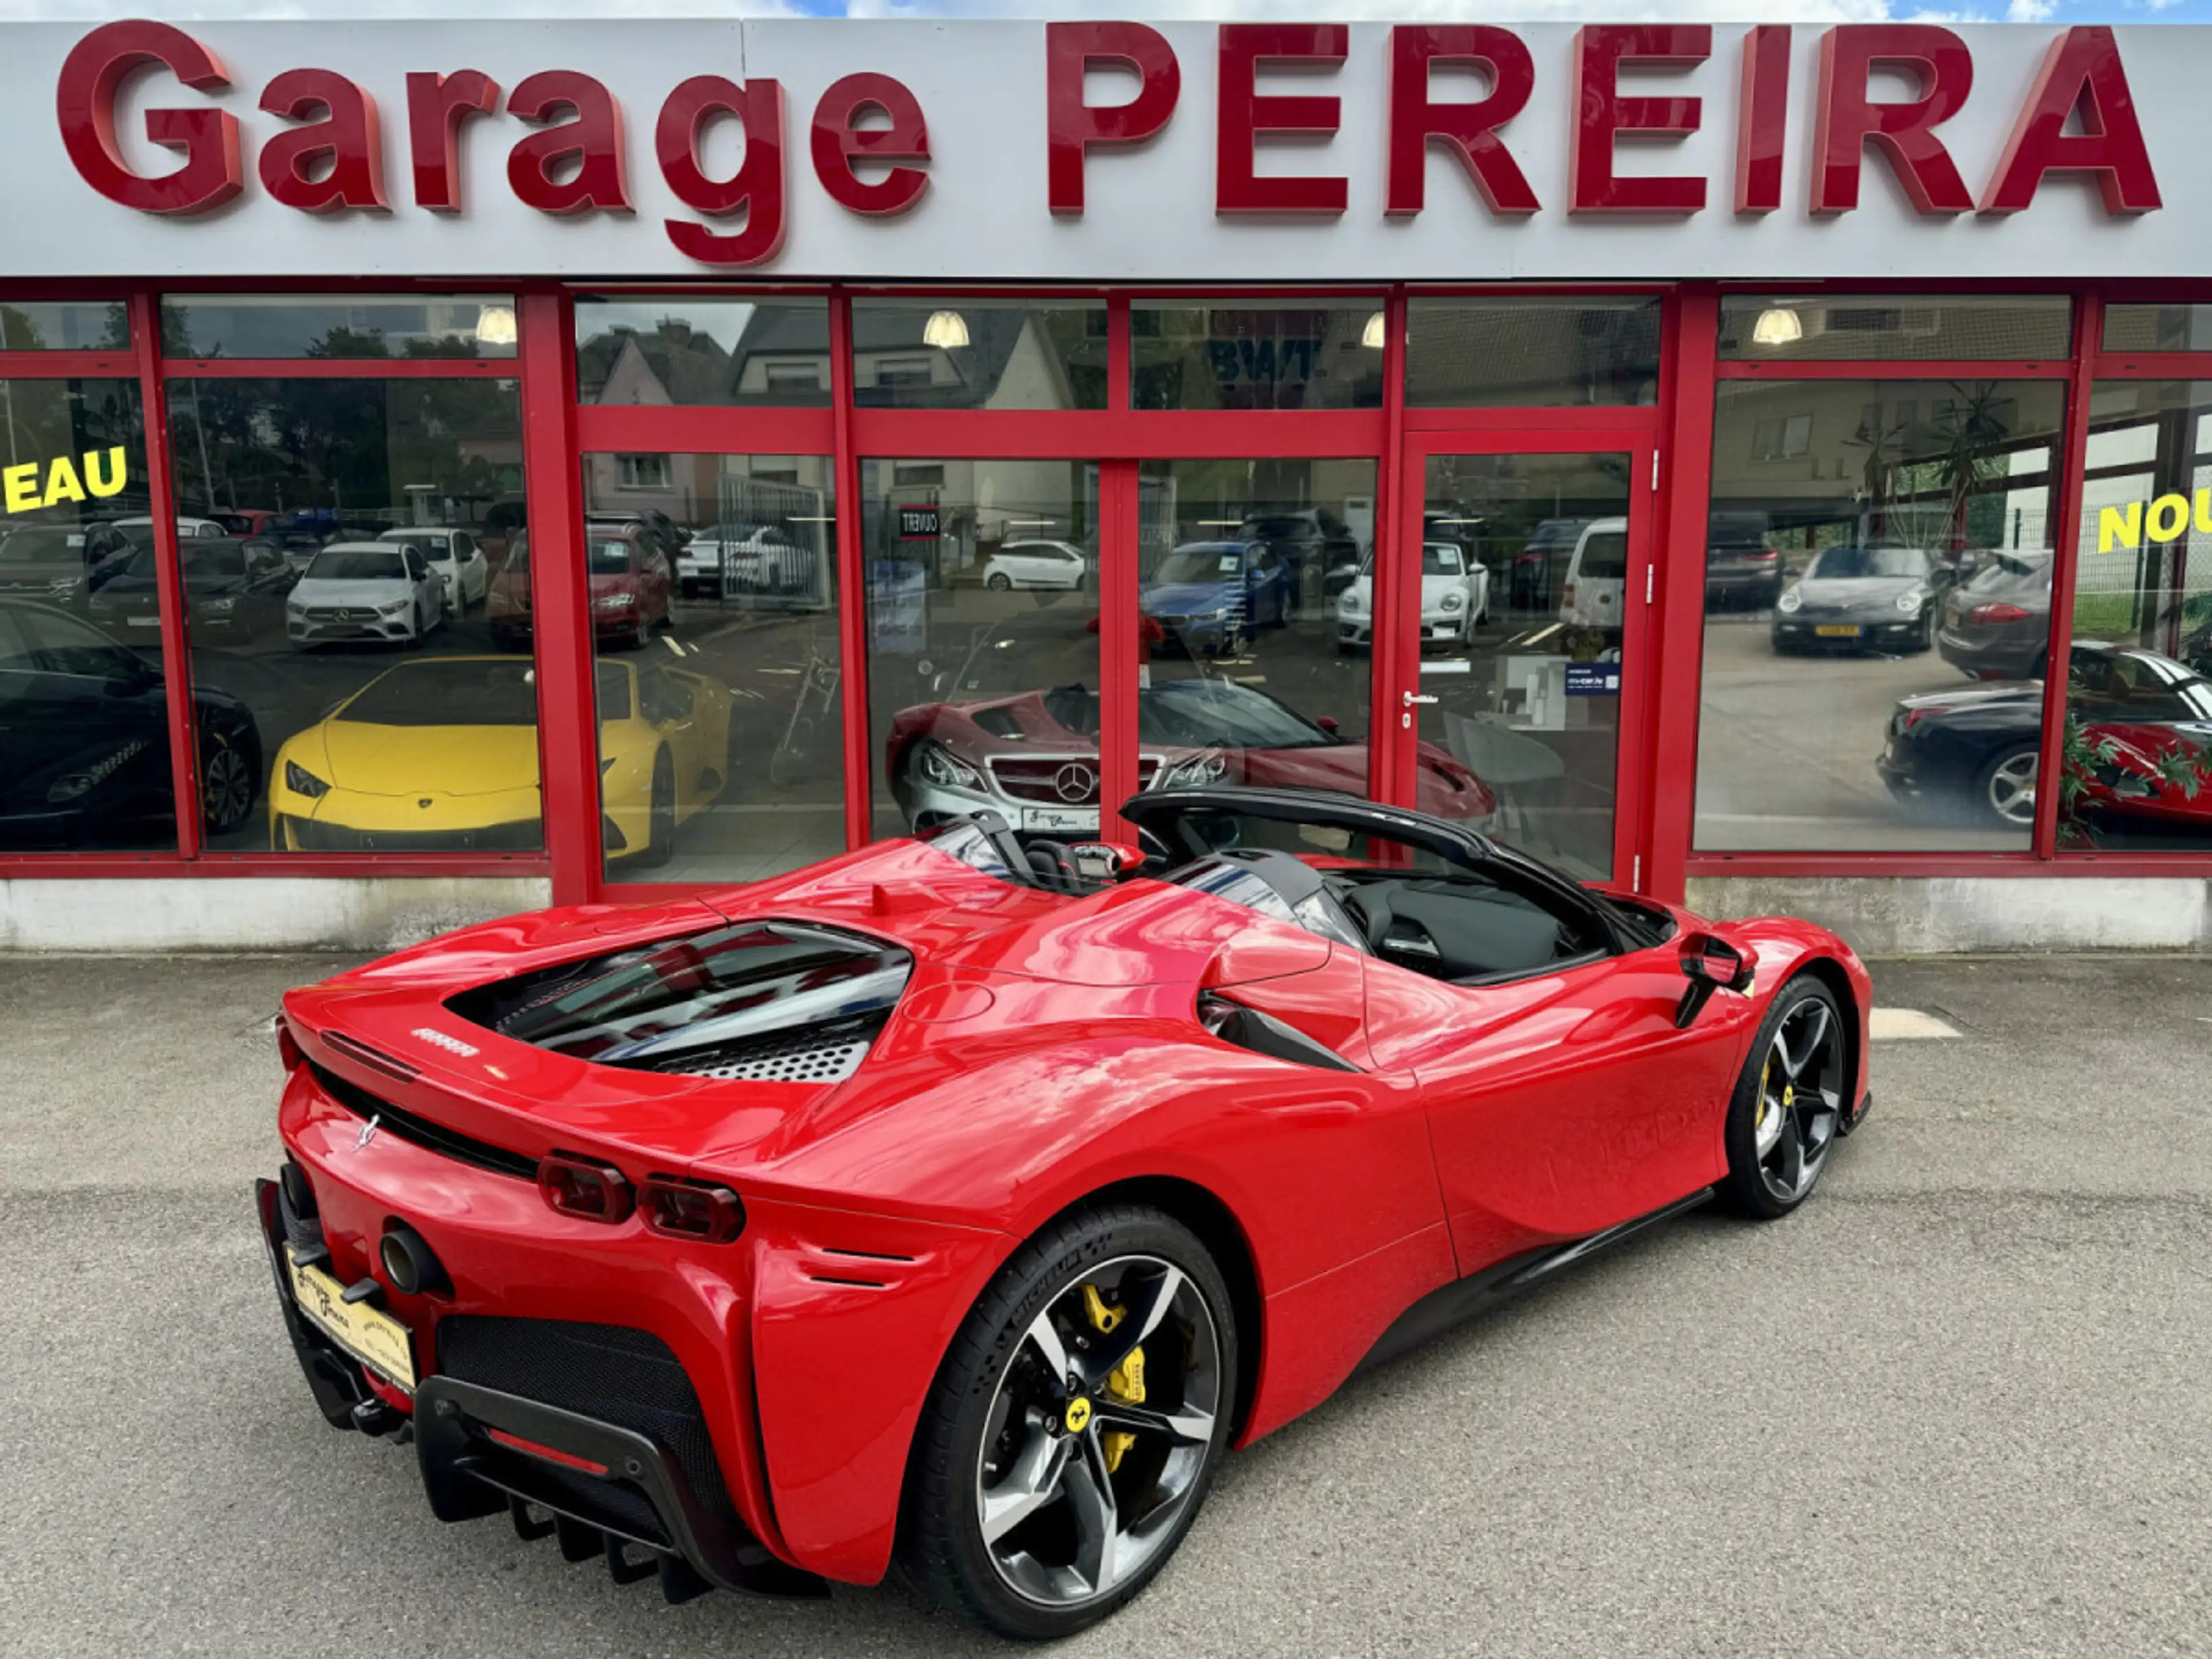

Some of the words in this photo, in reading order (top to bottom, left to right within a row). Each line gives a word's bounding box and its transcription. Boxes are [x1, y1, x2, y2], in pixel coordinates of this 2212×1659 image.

[56, 18, 932, 267] Garage
[1046, 21, 2162, 217] PEREIRA
[3, 446, 127, 514] EAU
